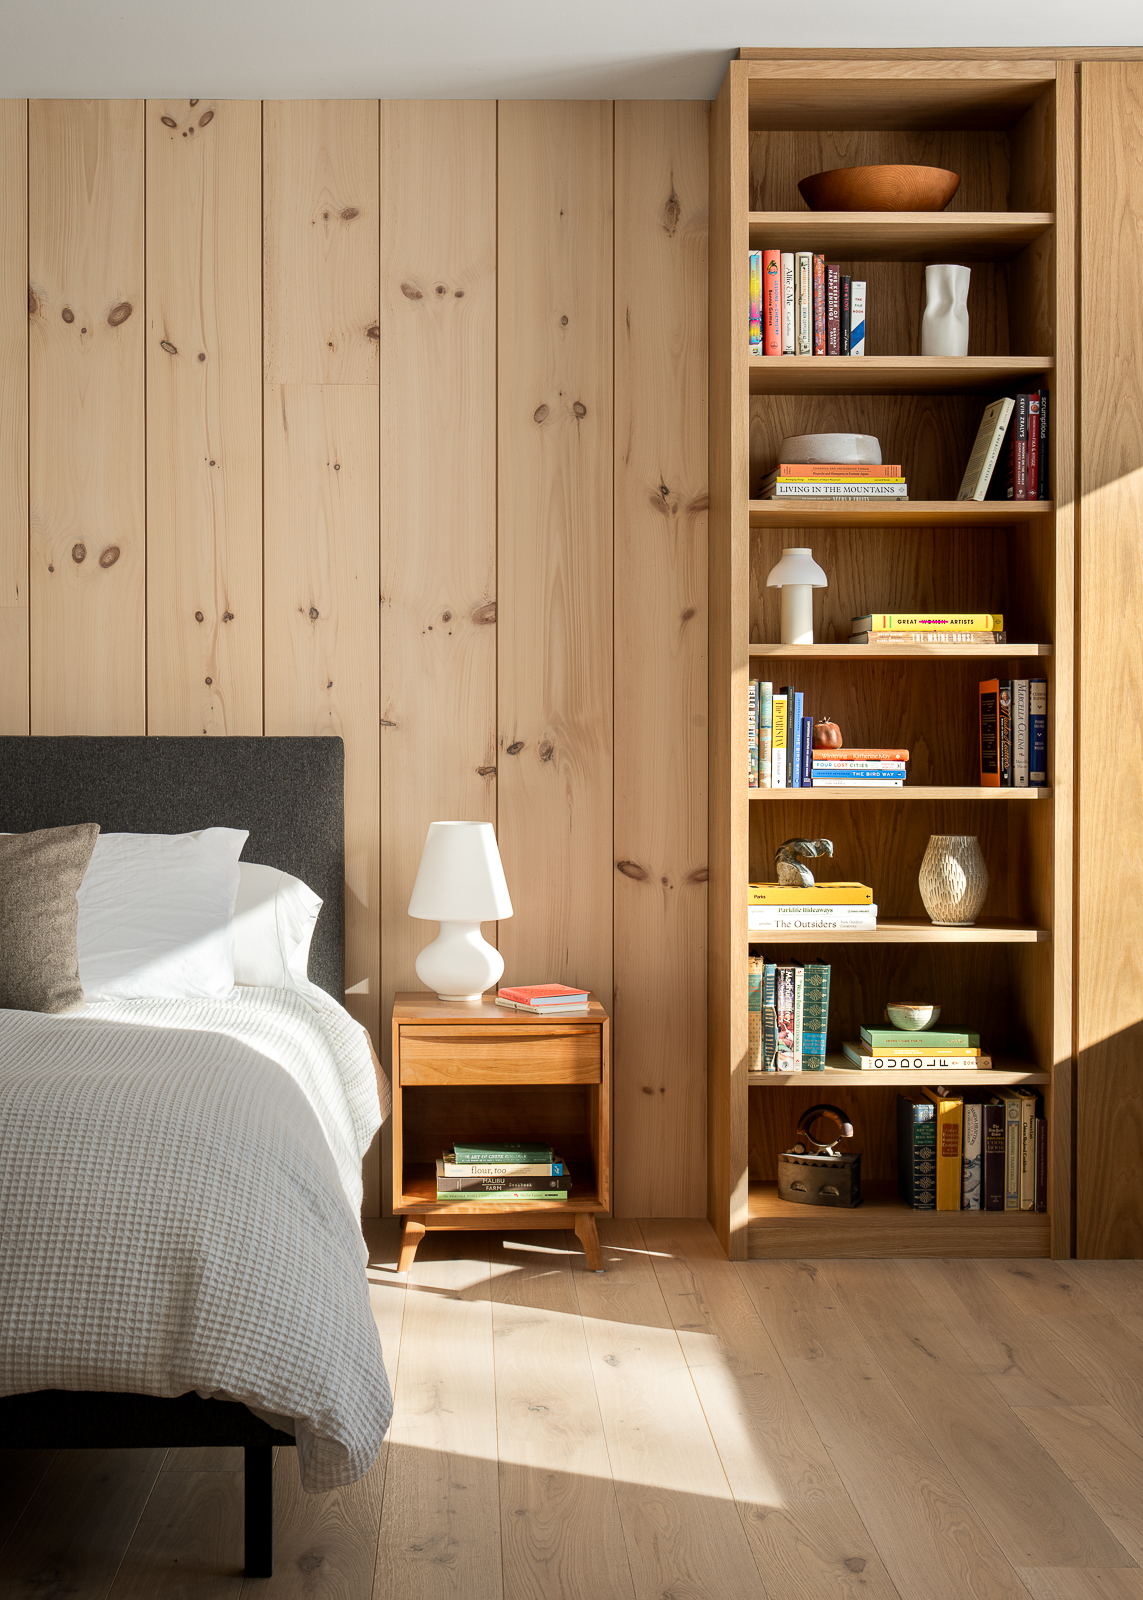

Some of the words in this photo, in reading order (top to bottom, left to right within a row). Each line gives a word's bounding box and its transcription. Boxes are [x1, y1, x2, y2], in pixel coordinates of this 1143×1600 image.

[786, 294, 793, 306] Me
[833, 310, 838, 318] OF
[991, 434, 1002, 460] AMERICAN
[912, 633, 925, 642] THE
[927, 633, 950, 642] MAINE
[952, 633, 975, 642] HOUSE
[1017, 683, 1027, 720] MARCELLA
[775, 702, 784, 714] The
[775, 715, 784, 747] PARISIAN
[1017, 722, 1027, 750] CUCINA
[774, 919, 792, 928] The
[793, 919, 837, 928] Outsiders
[785, 970, 793, 999] Madhur
[784, 999, 793, 1024] Jaffrey
[874, 1058, 949, 1068] OUDOLF
[471, 1165, 493, 1174] flour,
